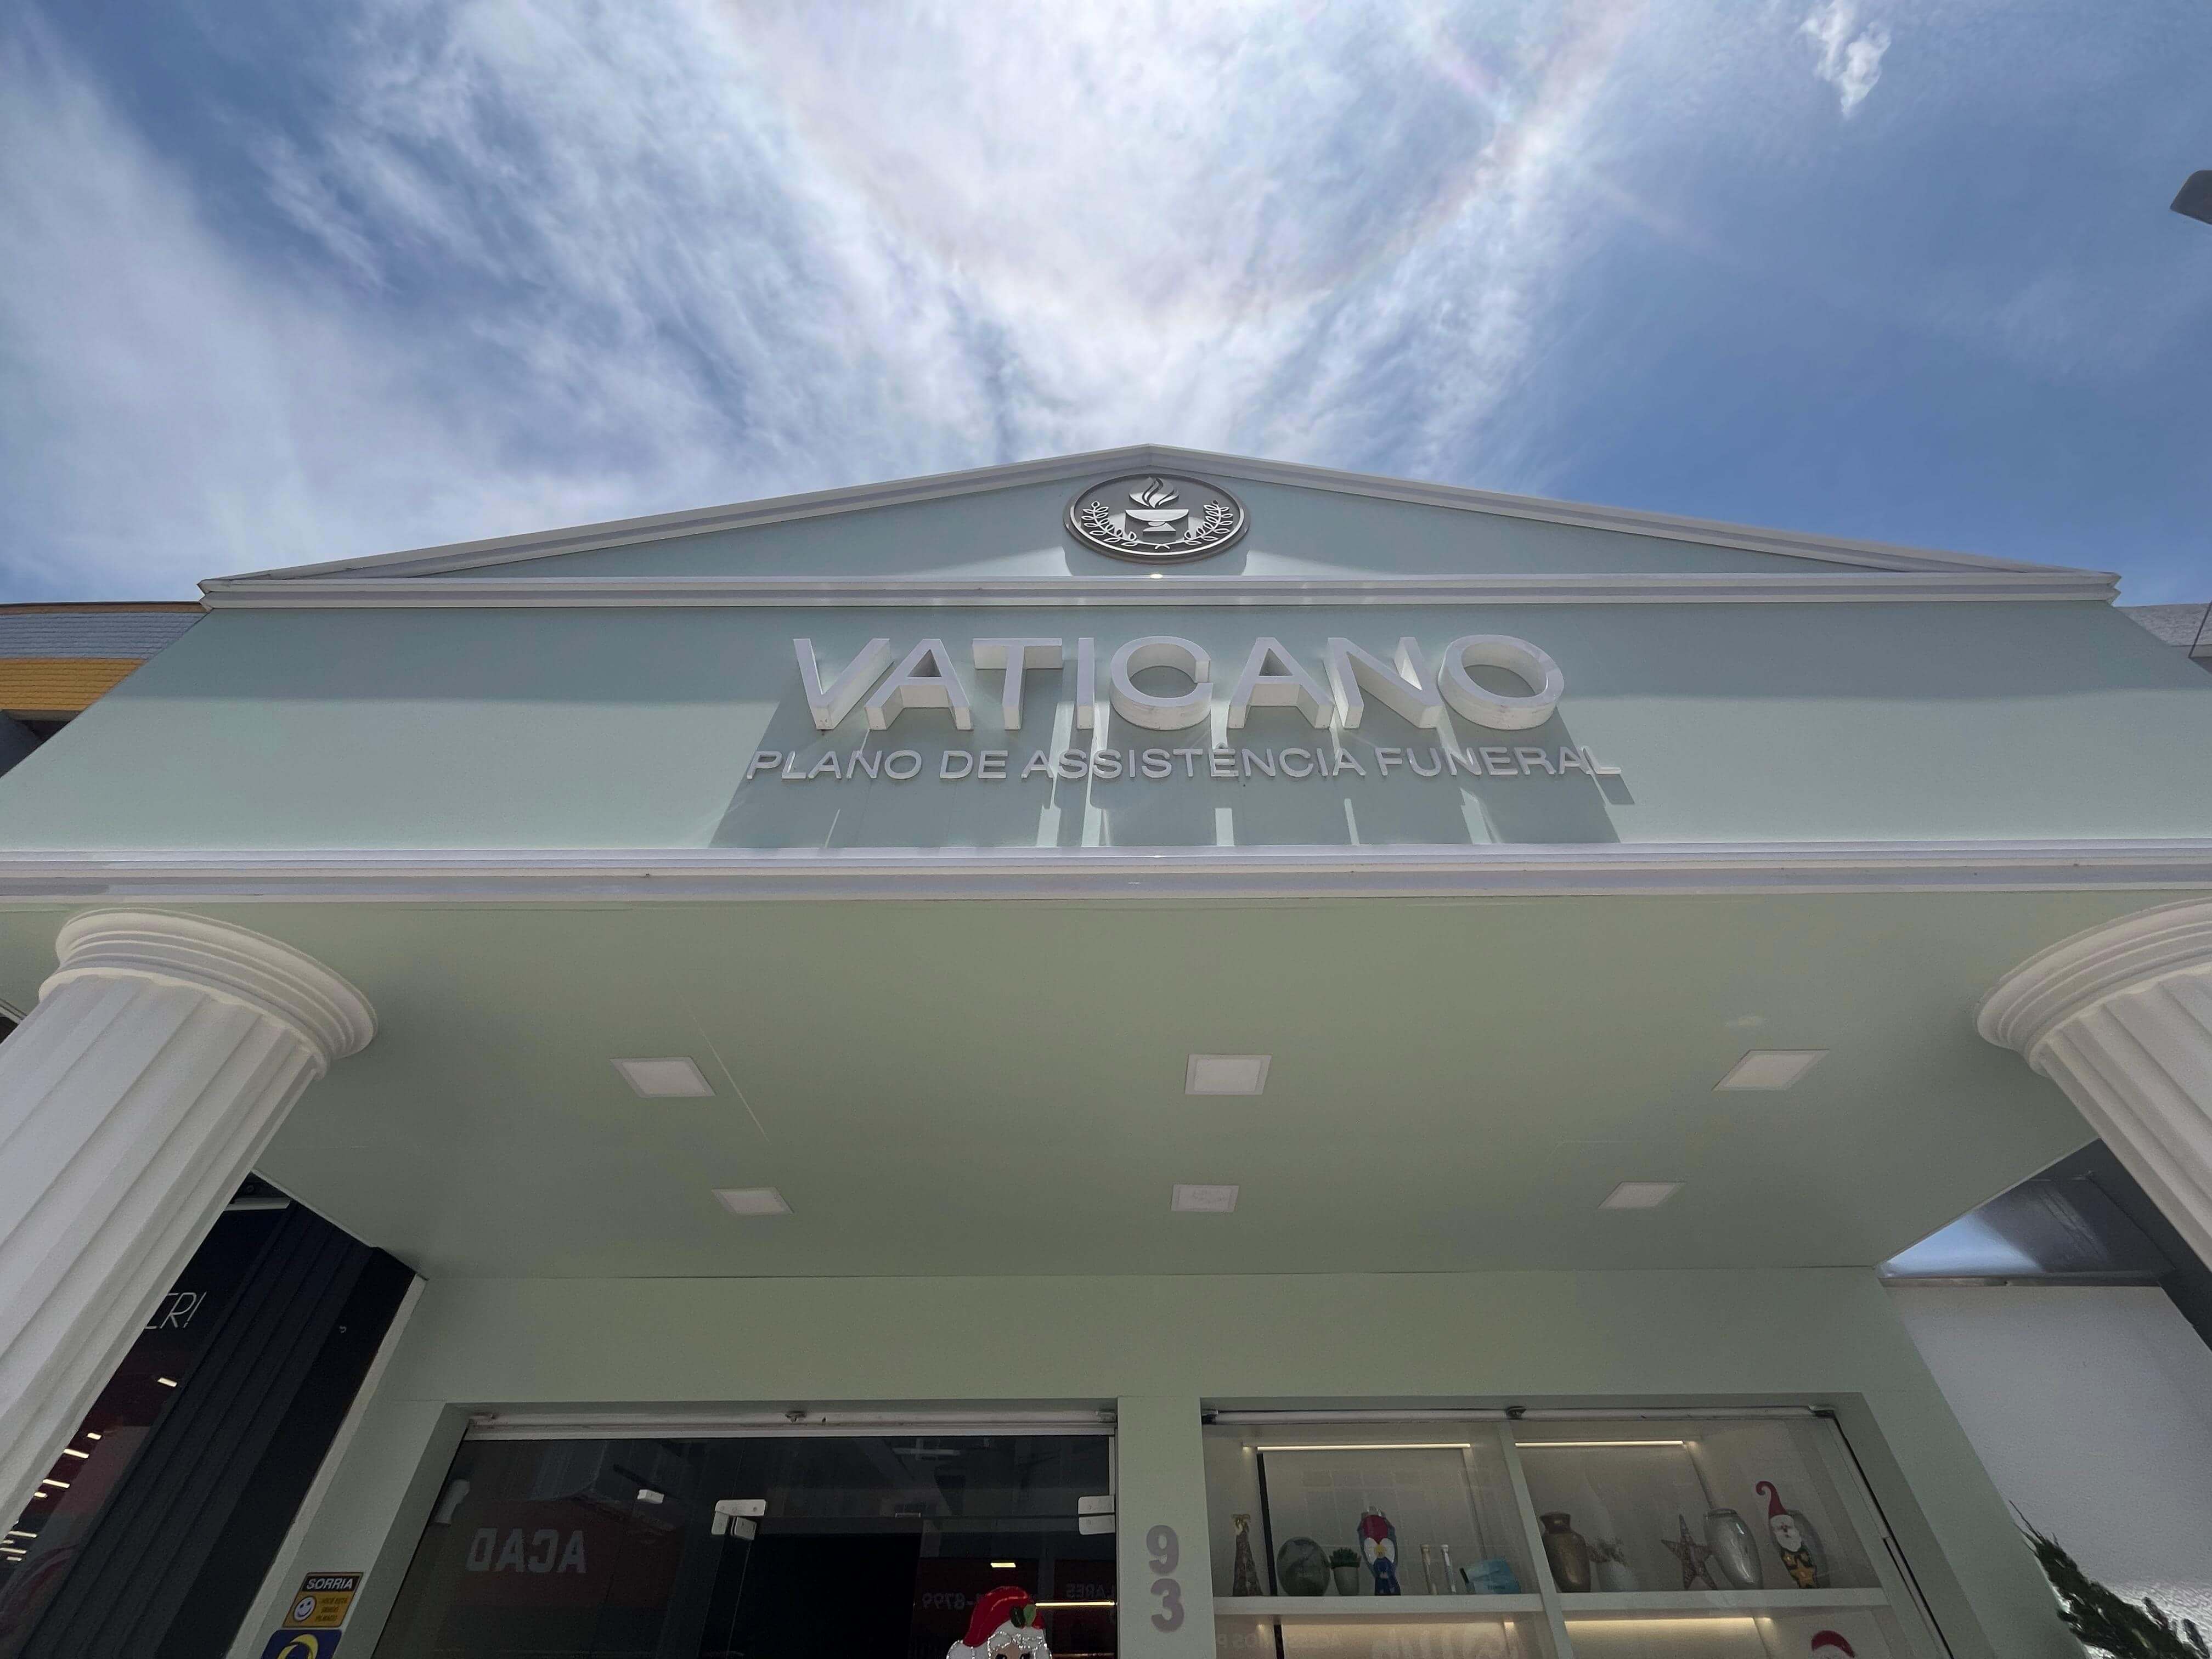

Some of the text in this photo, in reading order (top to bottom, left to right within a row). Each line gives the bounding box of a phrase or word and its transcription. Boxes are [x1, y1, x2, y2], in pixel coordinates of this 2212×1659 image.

[793, 634, 1565, 730] VATICANO
[747, 743, 1622, 780] PLANO DE ASSISTÊNCIA FUNERAL
[306, 1578, 353, 1590] SORRIA
